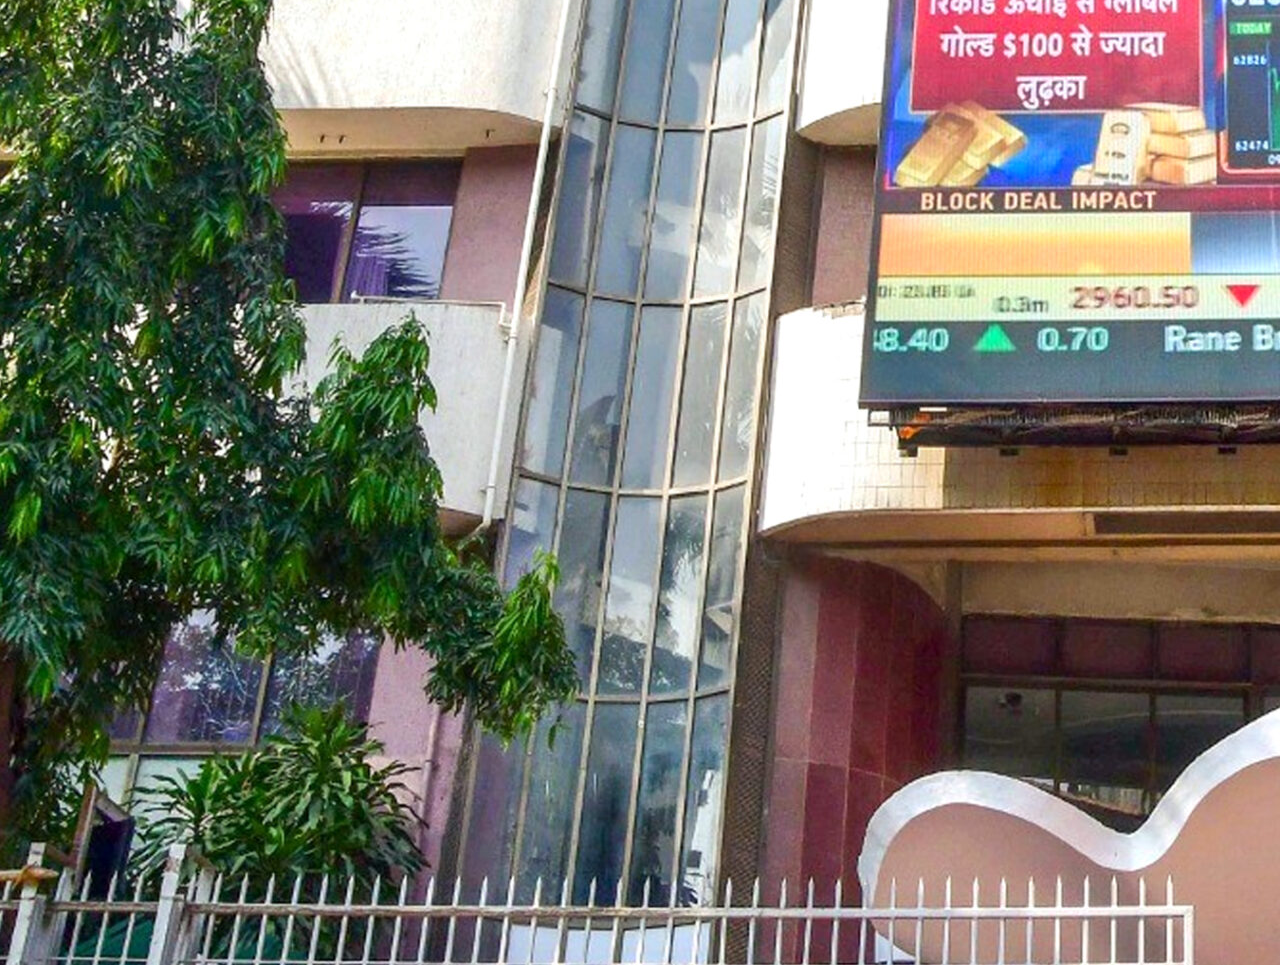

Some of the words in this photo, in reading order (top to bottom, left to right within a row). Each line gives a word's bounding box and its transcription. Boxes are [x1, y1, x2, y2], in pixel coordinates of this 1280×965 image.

[1236, 22, 1271, 34] TODAY
[940, 25, 996, 57] गोल्ड
[1003, 32, 1062, 57] $100
[1071, 24, 1092, 56] से
[1100, 32, 1165, 56] ज्यादा
[1016, 76, 1086, 109] लुढ़का
[1235, 140, 1270, 151] 62474
[921, 191, 996, 211] BLOCK
[1004, 191, 1062, 210] DEAL
[1072, 191, 1157, 209] IMPACT
[1070, 285, 1200, 309] 2960.50
[1037, 327, 1109, 352] 0.70
[1164, 324, 1242, 352] Rane
